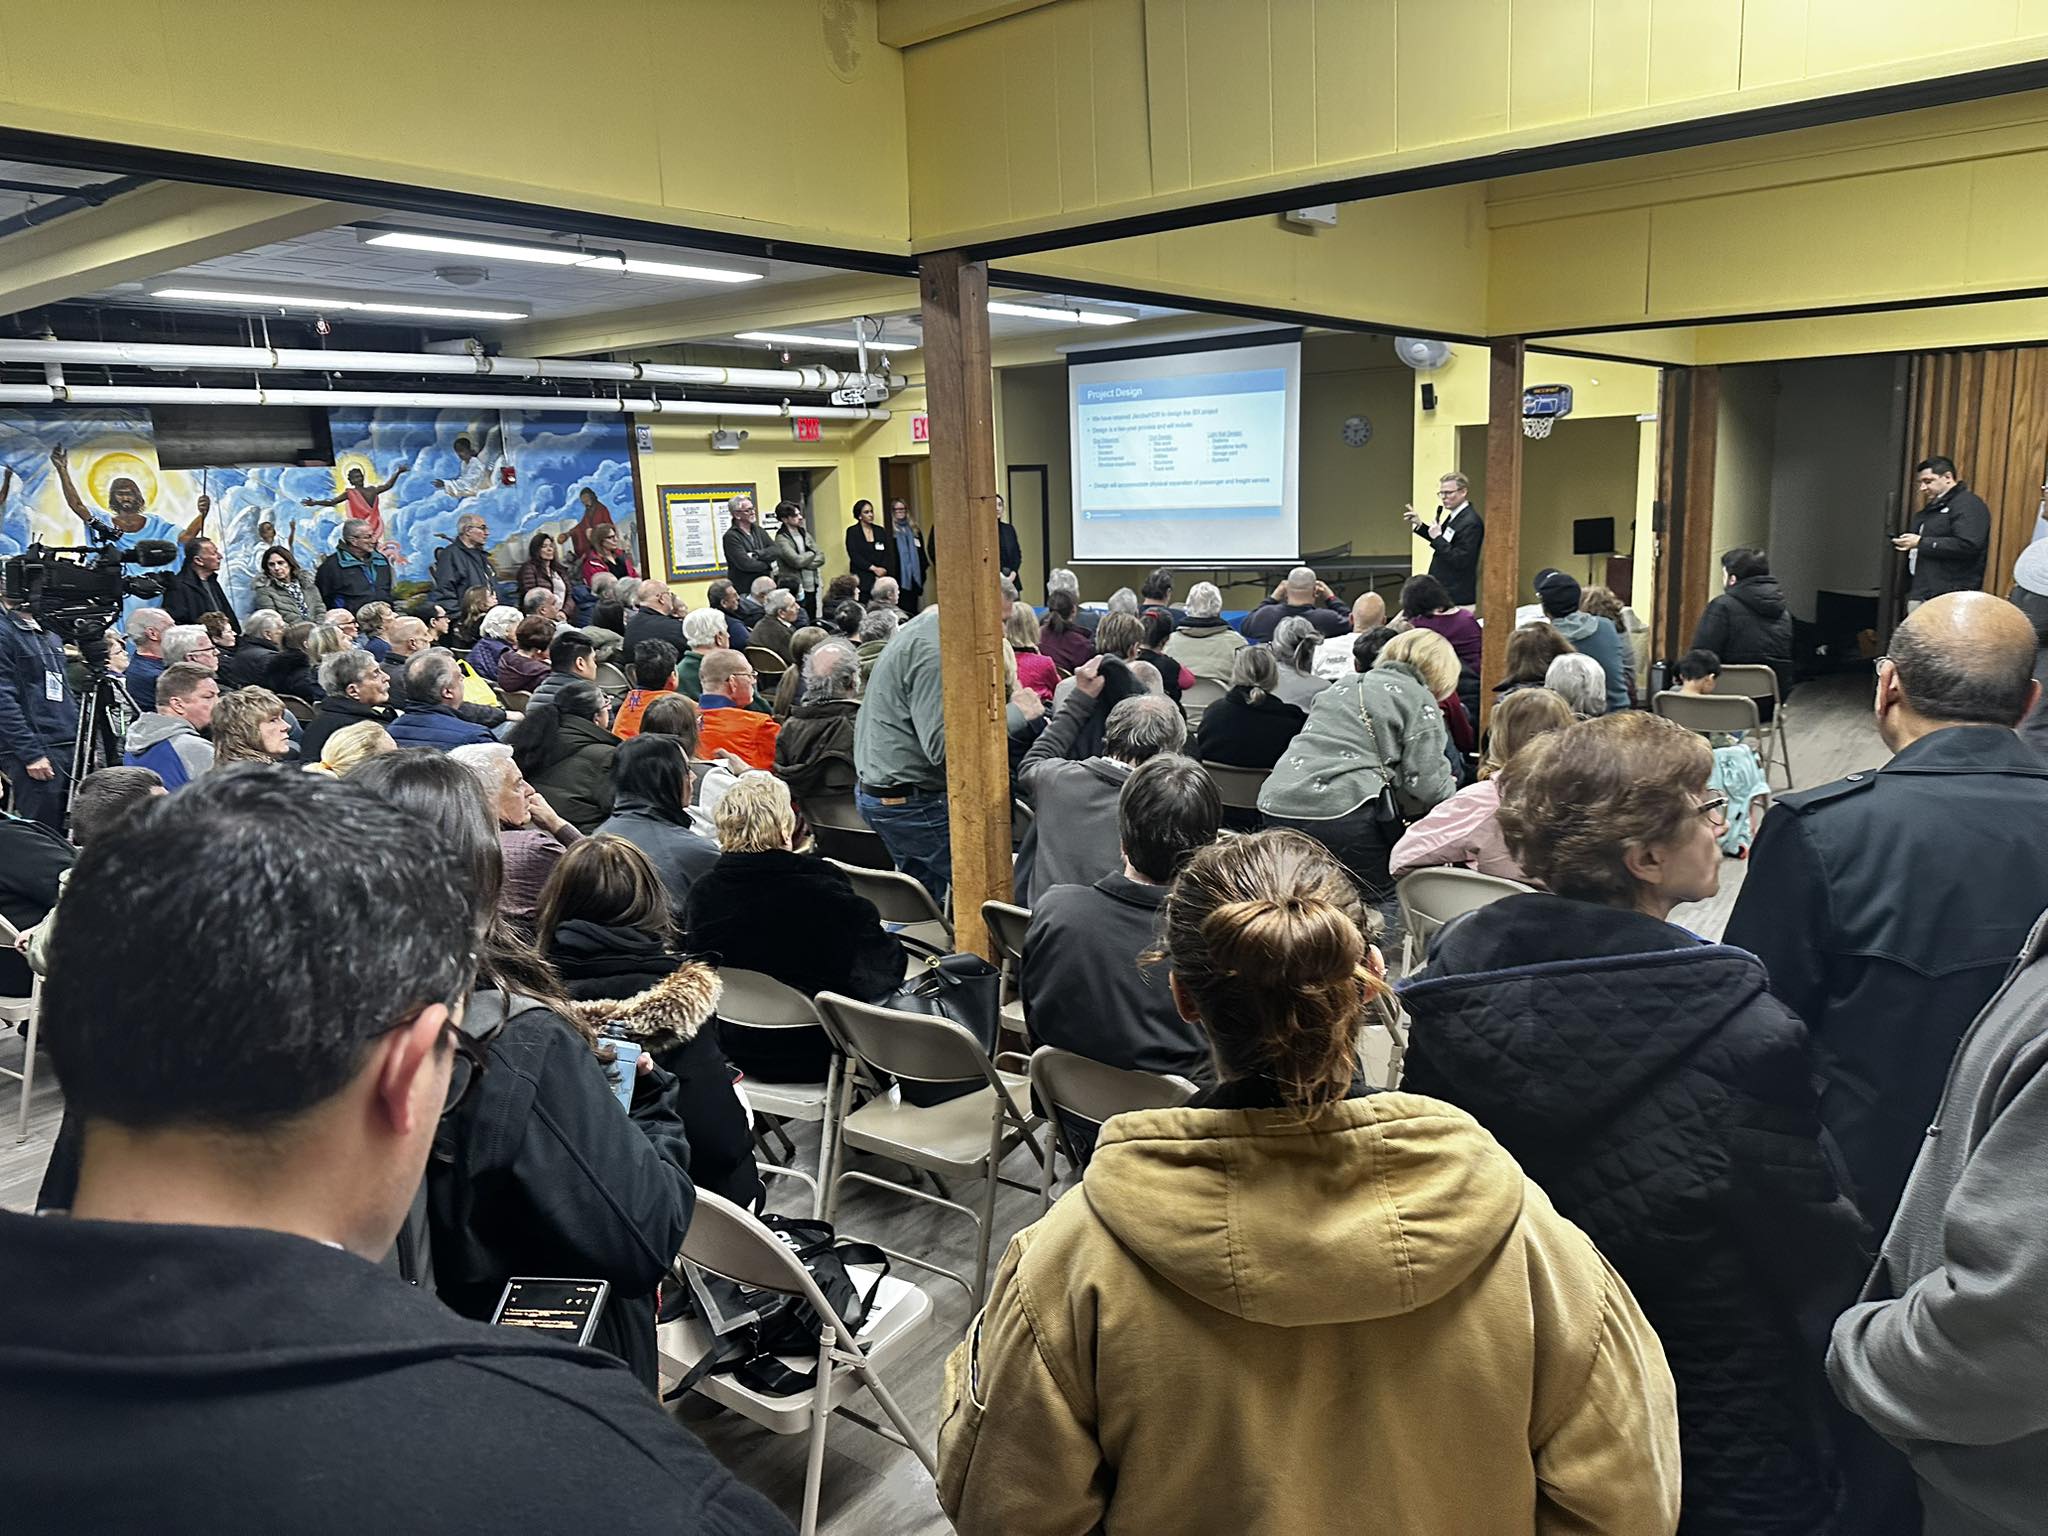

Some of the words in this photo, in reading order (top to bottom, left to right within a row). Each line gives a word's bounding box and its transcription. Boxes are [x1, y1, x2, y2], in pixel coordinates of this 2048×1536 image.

[1087, 388, 1114, 400] Project
[1115, 387, 1143, 398] Design
[797, 416, 820, 441] EXIT
[914, 417, 928, 440] EX
